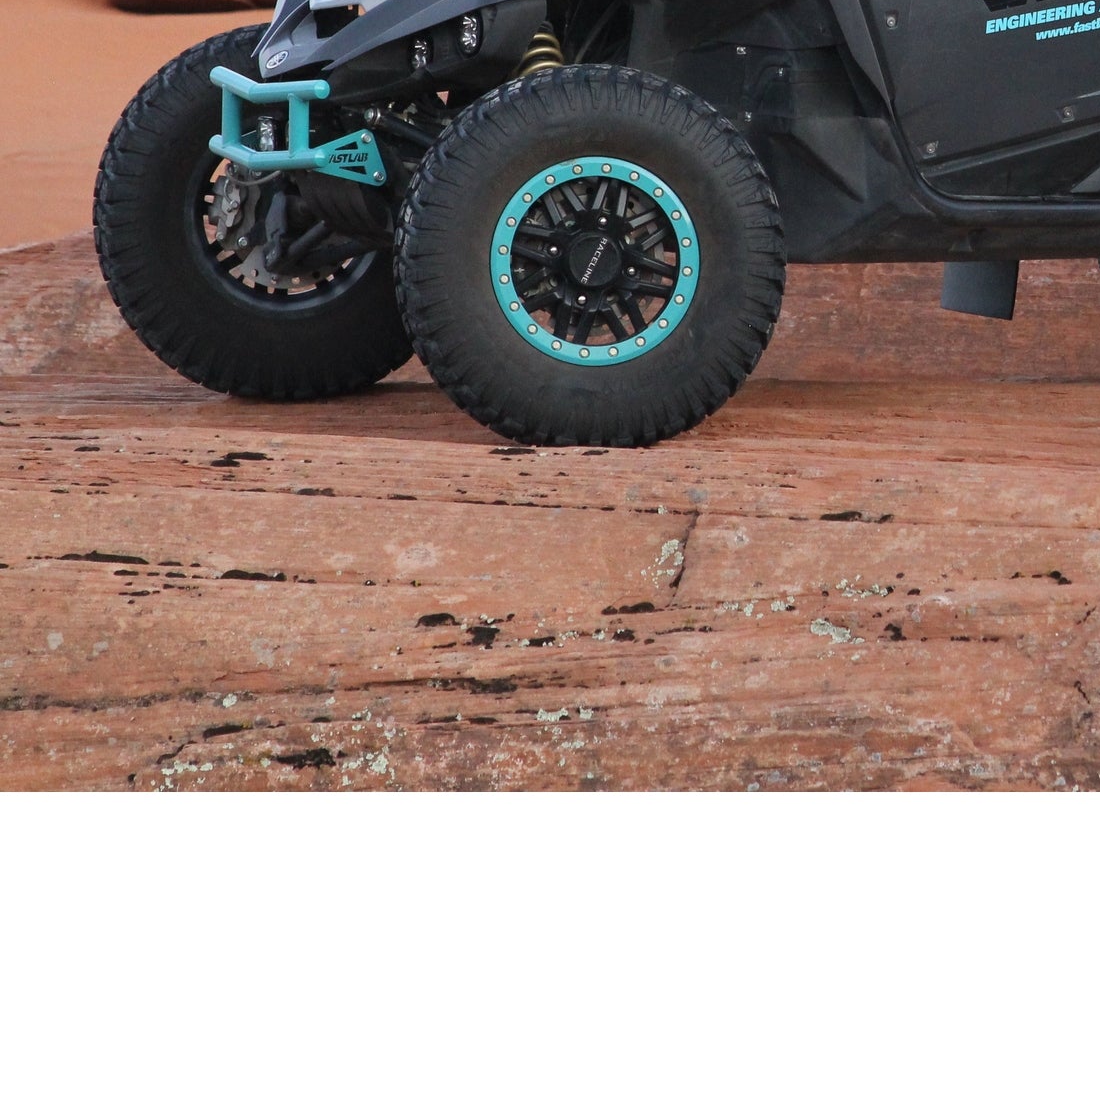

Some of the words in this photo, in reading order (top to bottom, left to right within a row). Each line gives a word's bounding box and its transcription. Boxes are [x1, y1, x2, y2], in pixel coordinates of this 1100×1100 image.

[985, 1, 1096, 34] ENGINEERING
[328, 152, 369, 164] ASTLAB
[581, 237, 608, 284] RACELINE
